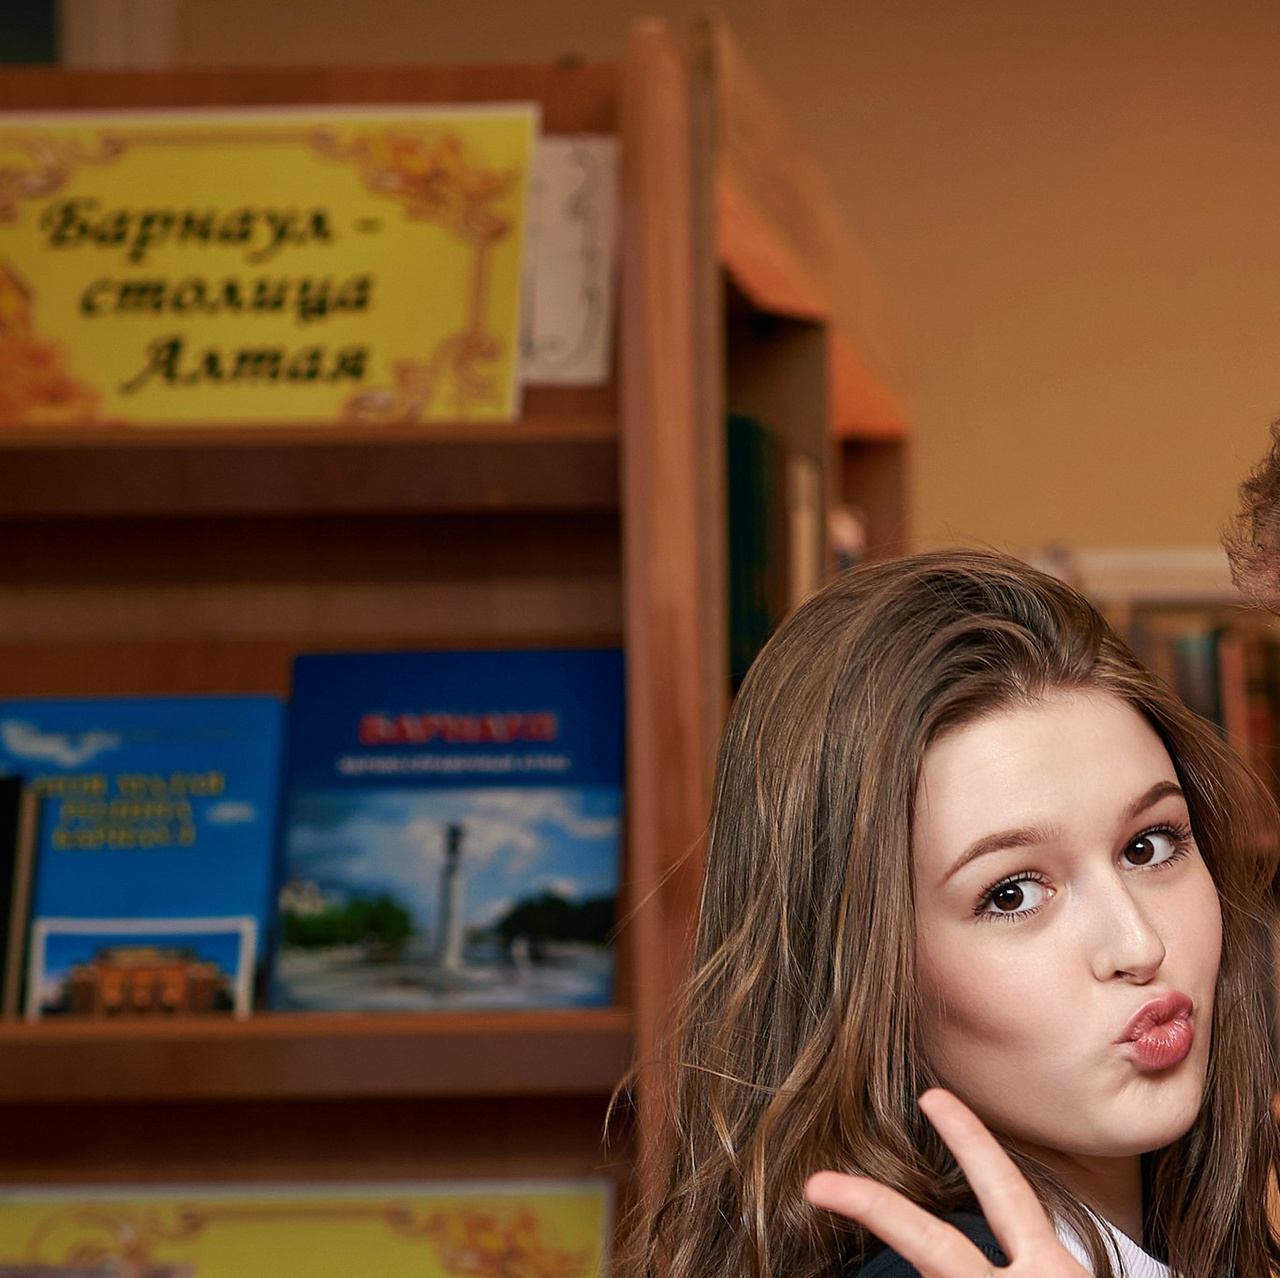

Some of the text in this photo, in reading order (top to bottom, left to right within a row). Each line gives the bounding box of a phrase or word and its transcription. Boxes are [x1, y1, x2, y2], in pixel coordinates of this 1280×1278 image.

[40, 198, 333, 265] Барнаул
[80, 273, 375, 325] столица
[117, 334, 371, 394] Алтая
